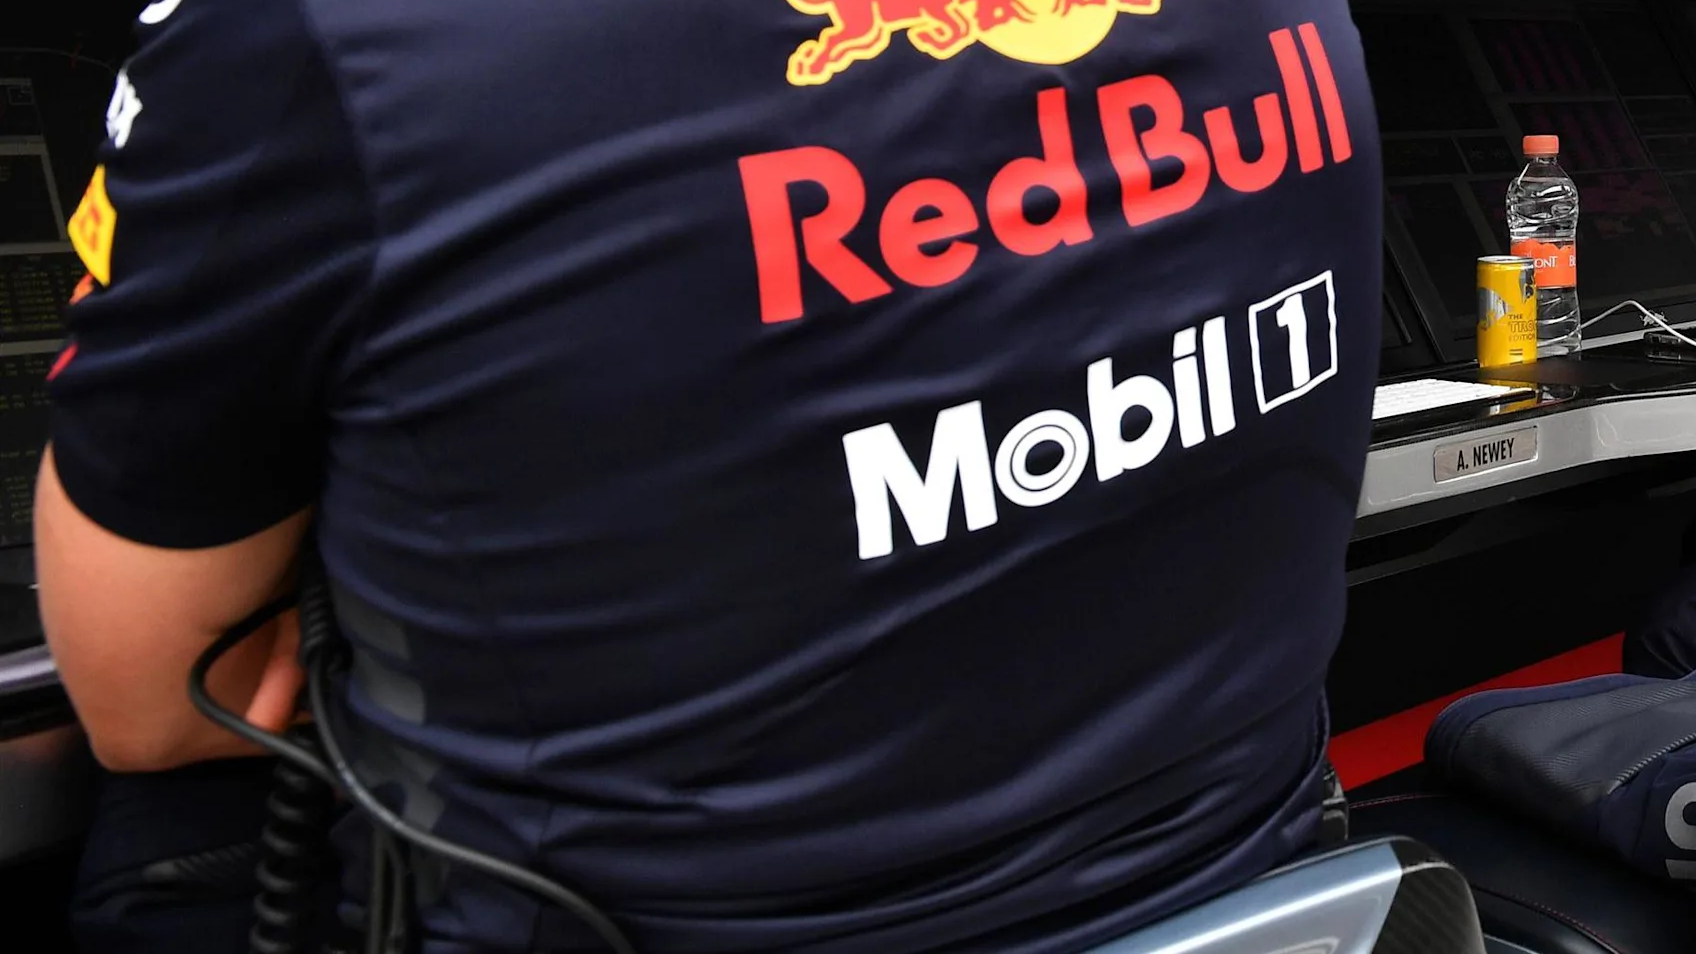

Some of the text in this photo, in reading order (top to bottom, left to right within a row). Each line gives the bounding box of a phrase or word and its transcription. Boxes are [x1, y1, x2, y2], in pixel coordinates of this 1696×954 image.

[737, 22, 1353, 324] Red Bull
[843, 317, 1237, 560] Mobil
[1456, 437, 1515, 471] A. NEWEY
